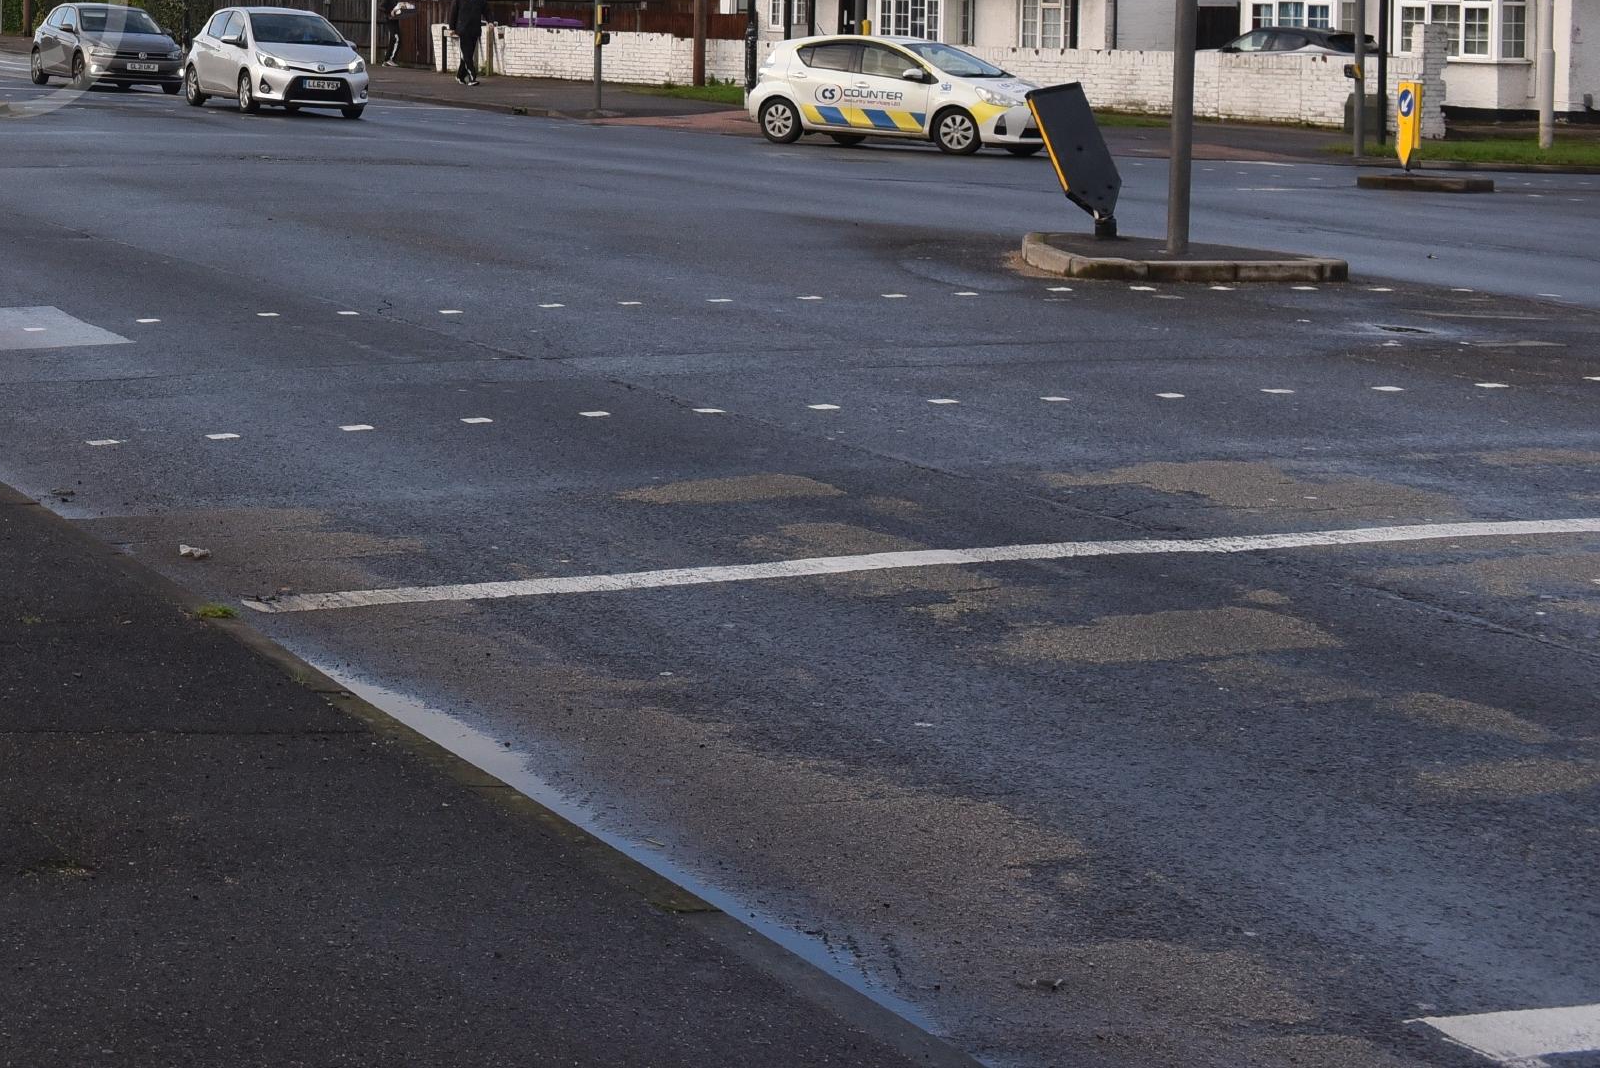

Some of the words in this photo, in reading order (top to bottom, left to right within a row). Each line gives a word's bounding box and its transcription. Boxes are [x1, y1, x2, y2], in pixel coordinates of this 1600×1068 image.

[308, 80, 325, 88] LL62
[822, 88, 836, 100] CS
[843, 88, 904, 100] COUNTER
